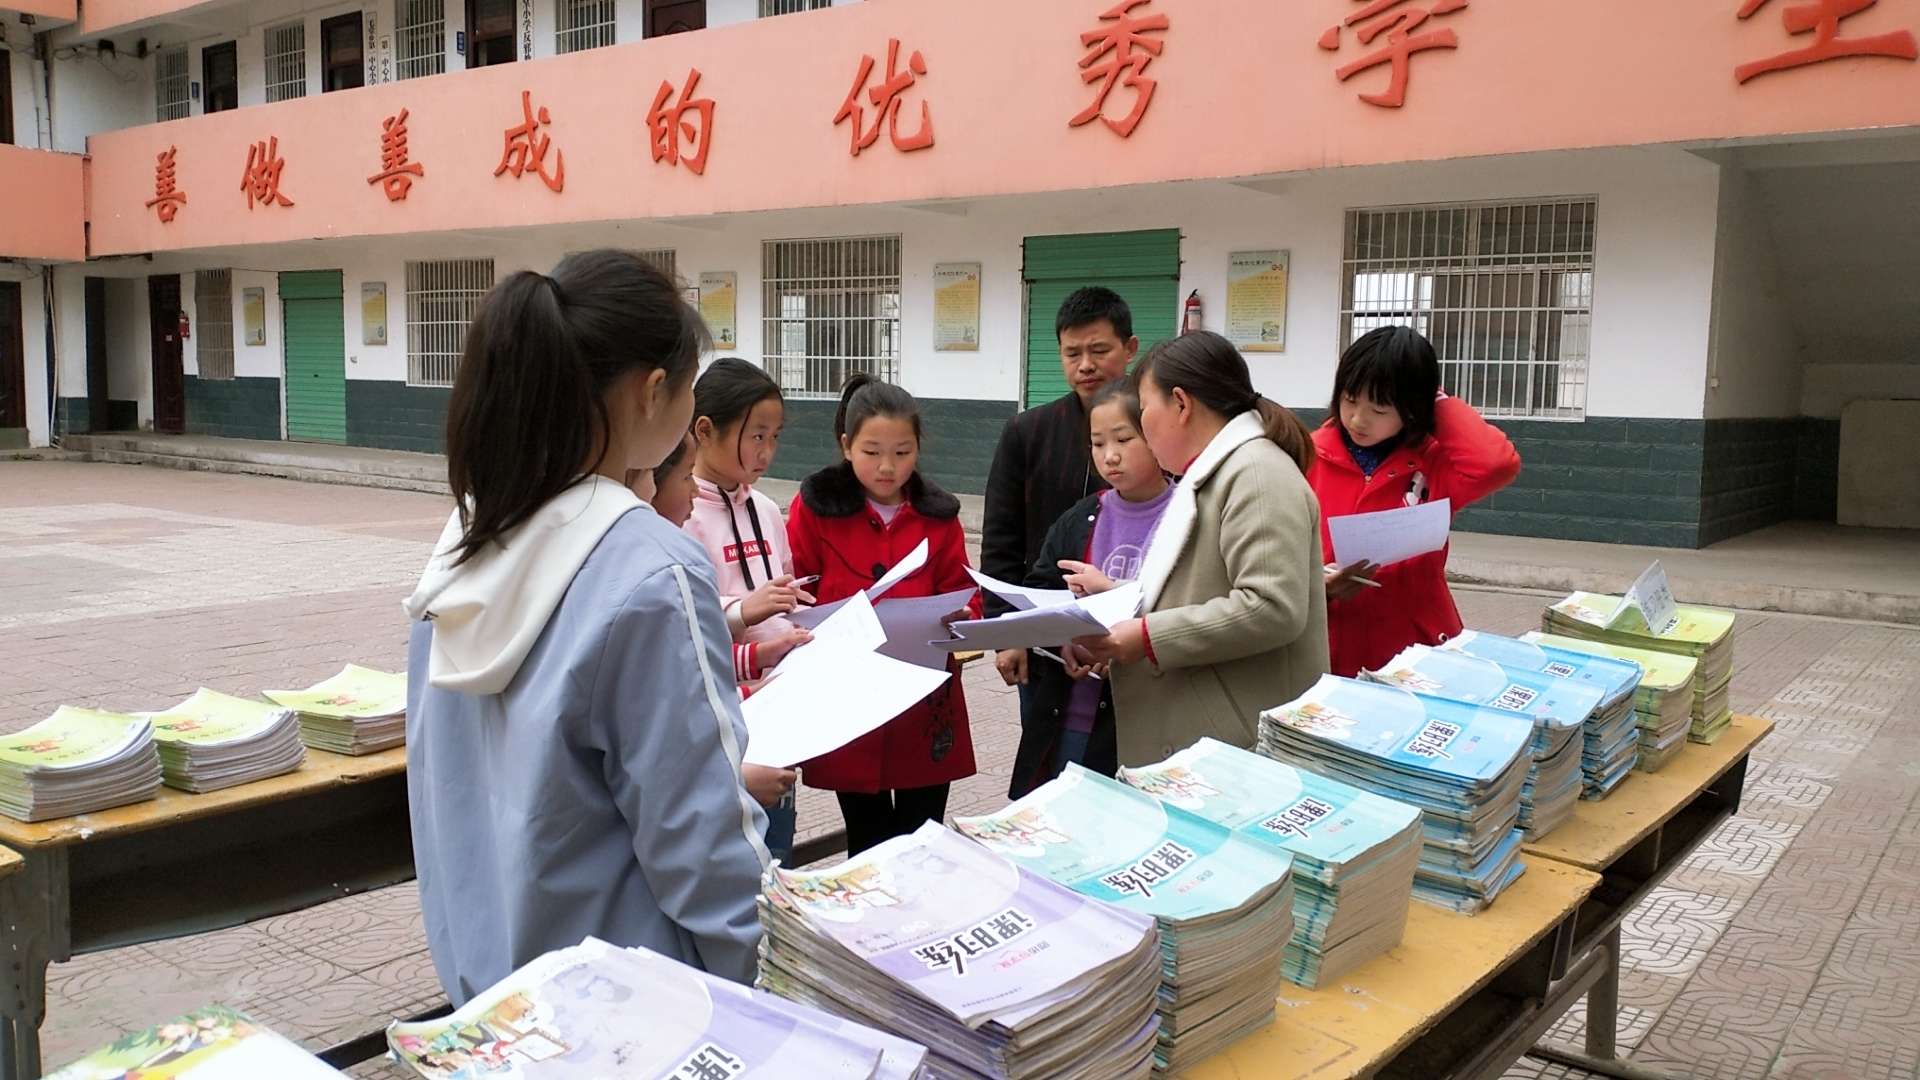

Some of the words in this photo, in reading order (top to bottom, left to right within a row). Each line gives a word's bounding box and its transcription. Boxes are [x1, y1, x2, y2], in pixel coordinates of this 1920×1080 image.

[1407, 720, 1458, 759] 课时练
[1263, 798, 1332, 837] 课时练
[1103, 842, 1193, 897] 课时练
[915, 910, 1033, 974] 课时练
[669, 1046, 741, 1080] 课
